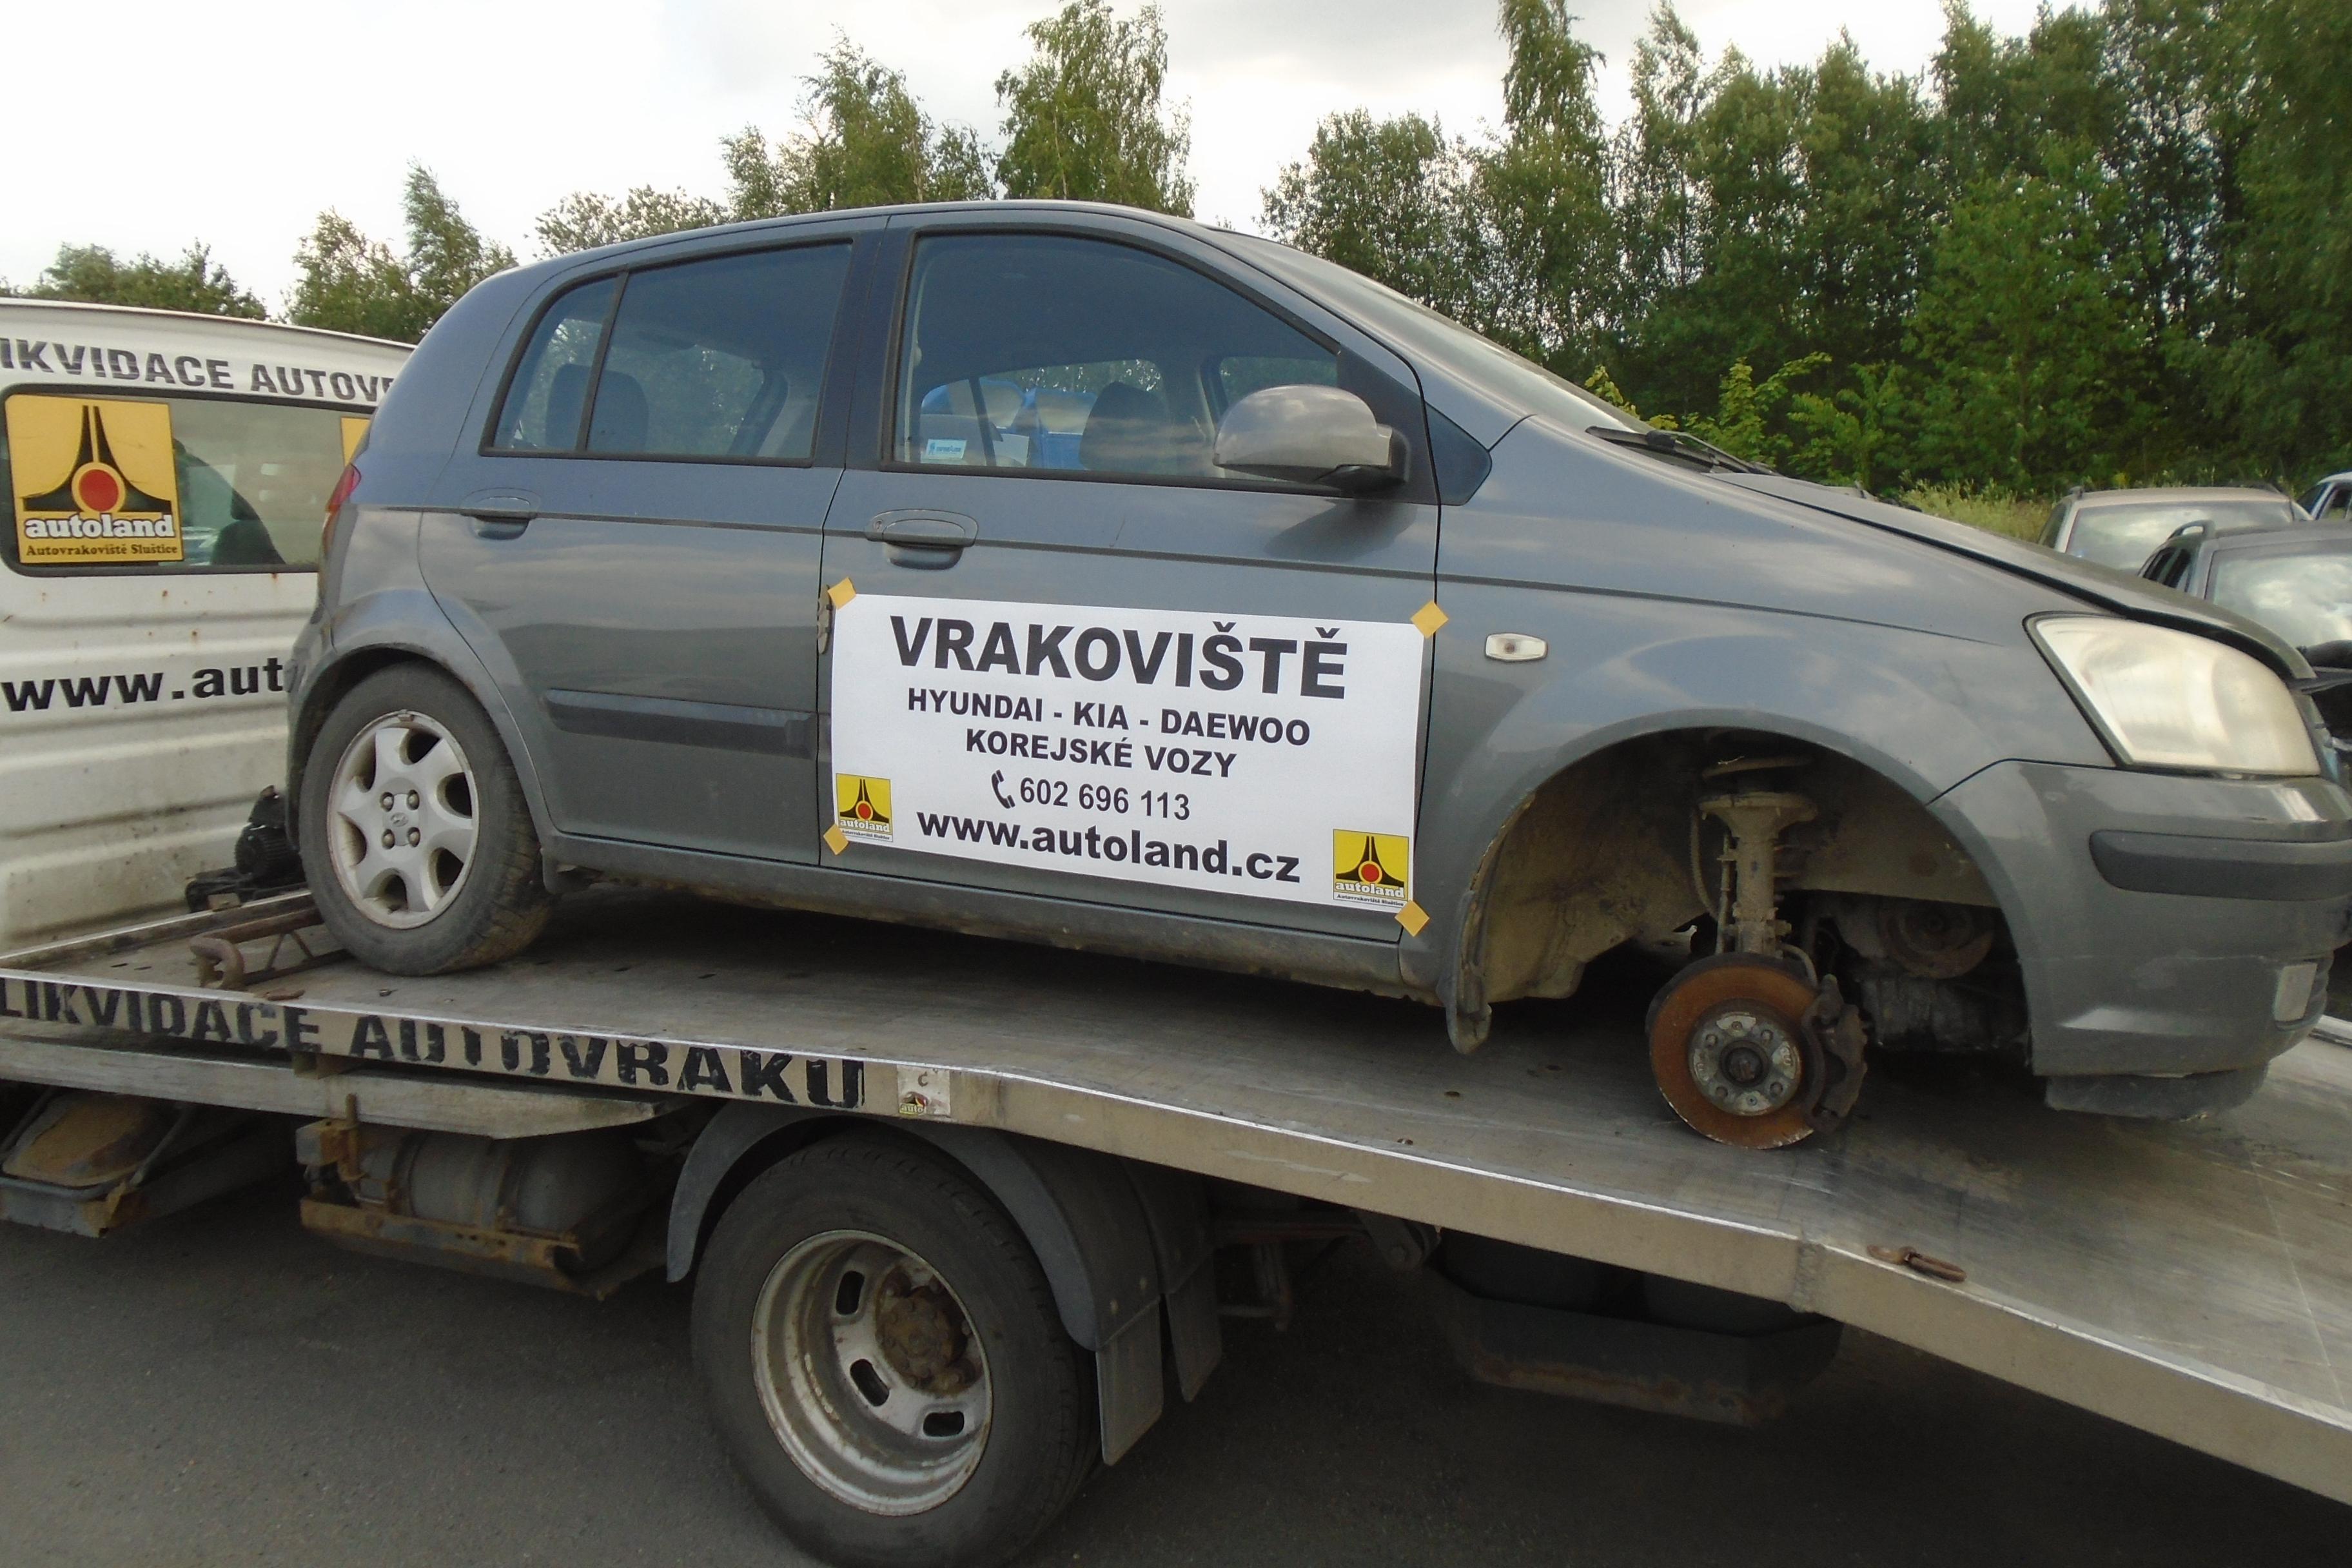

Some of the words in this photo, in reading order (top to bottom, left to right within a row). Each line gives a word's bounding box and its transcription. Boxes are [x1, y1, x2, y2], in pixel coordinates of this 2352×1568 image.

[24, 513, 176, 538] autoland
[26, 544, 127, 556] Autovrakoviště
[131, 544, 177, 554] Sluštice
[890, 615, 1348, 700] VRAKOVIŠTĚ
[1, 657, 283, 711] www.aut
[908, 687, 1043, 722] HYUNDAI
[1073, 701, 1129, 730] KIA
[1161, 709, 1310, 746] DAEWOO
[966, 729, 1133, 768] KOREJSKÉ
[1144, 745, 1237, 778] VOZY
[1020, 777, 1068, 807] 602
[1079, 783, 1129, 814] 696
[1141, 790, 1190, 821] 113
[839, 819, 890, 832] autoland
[916, 812, 1300, 883] www.autoland.cz
[1335, 881, 1405, 898] autoland
[0, 977, 321, 1054] LIKVIDACE
